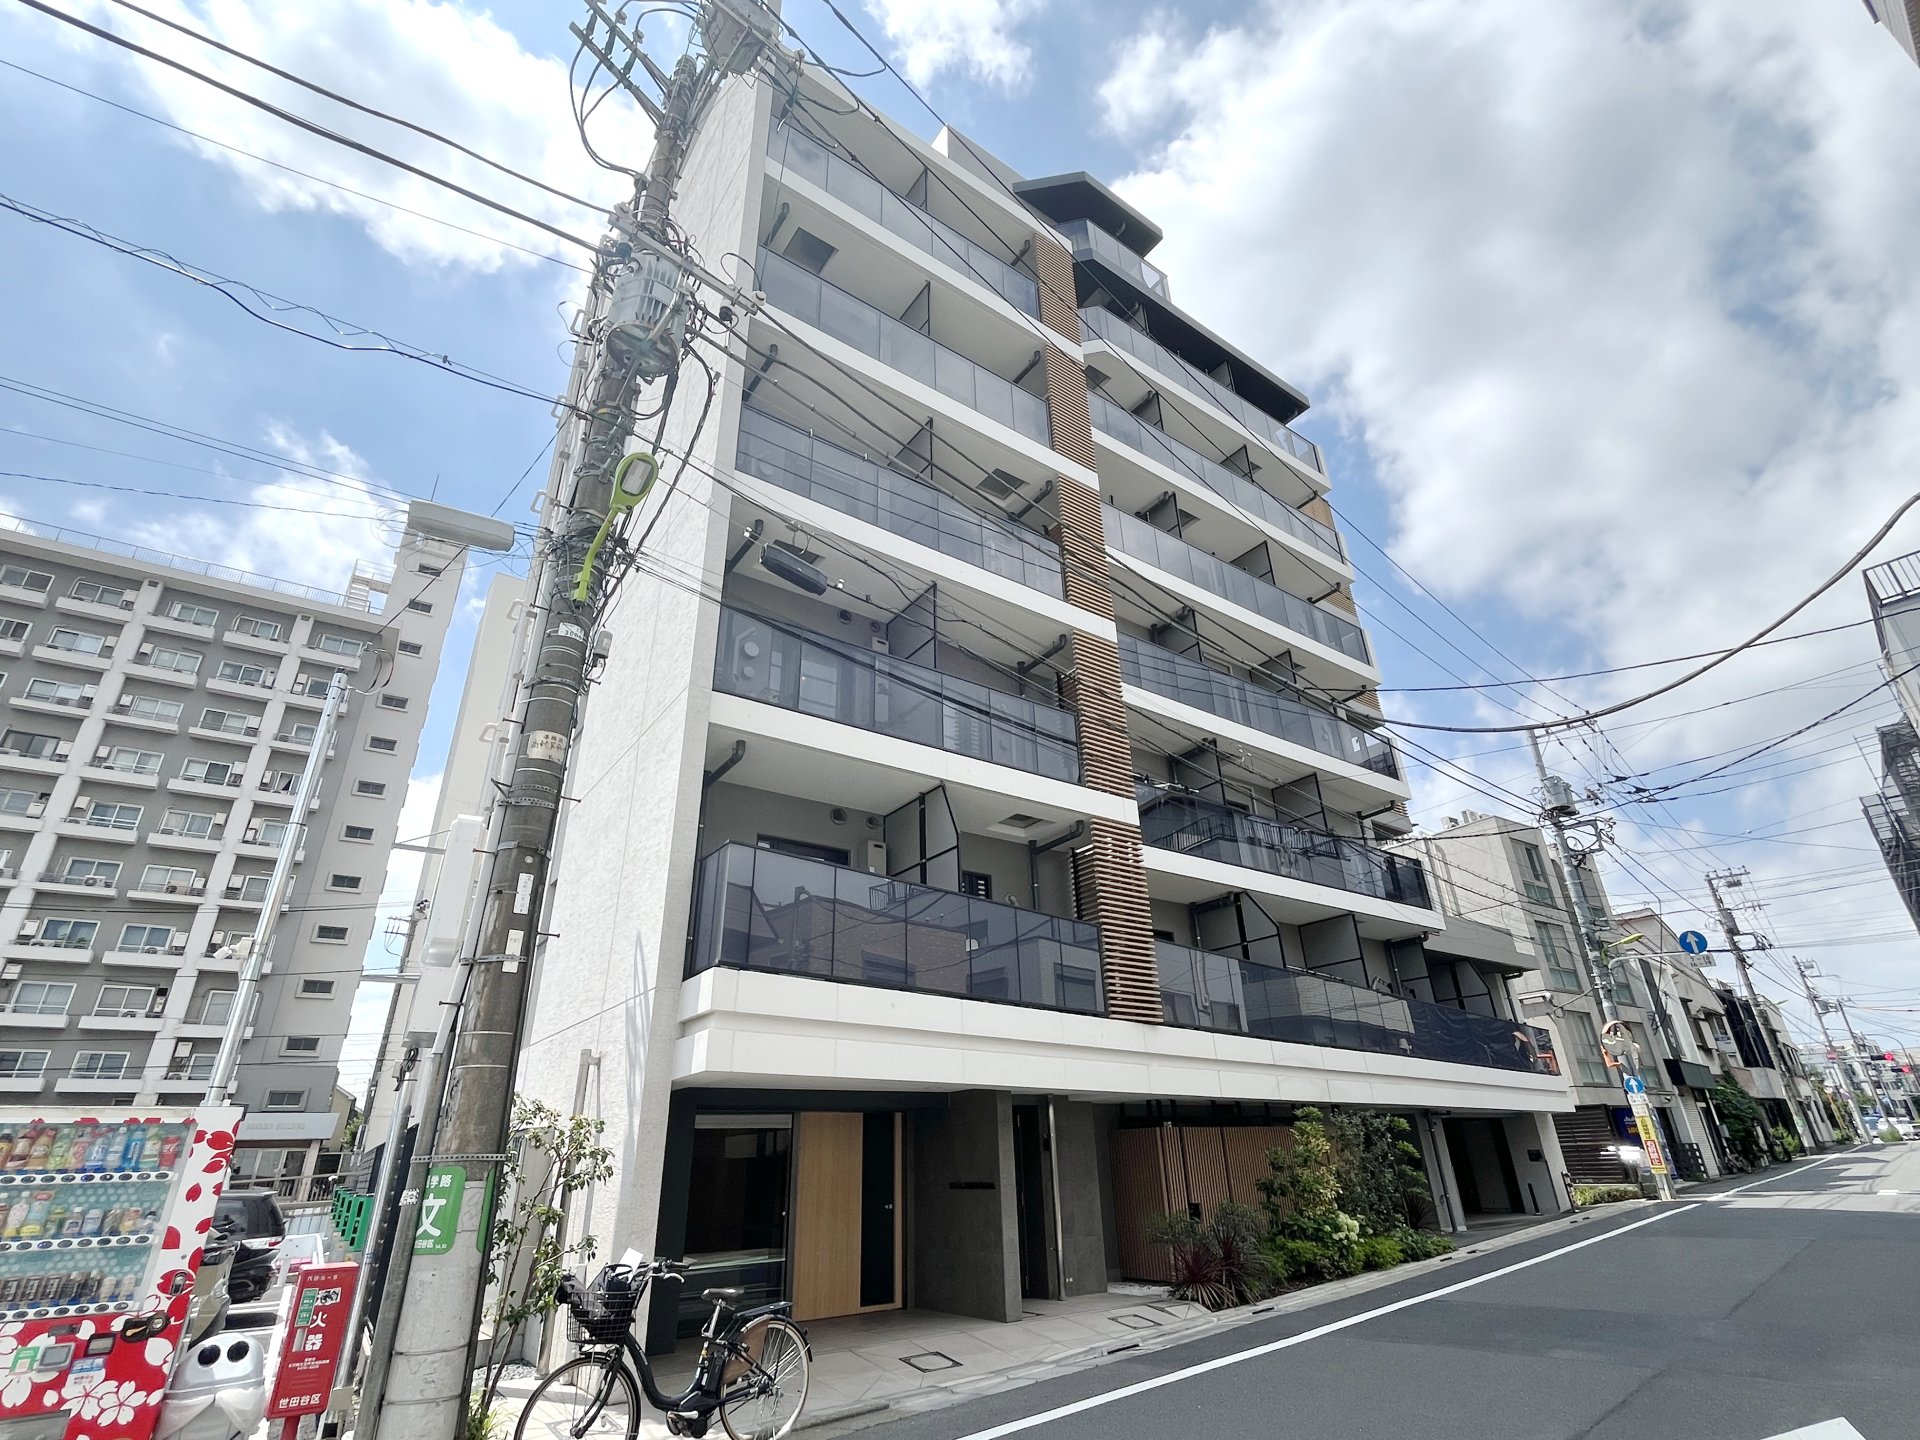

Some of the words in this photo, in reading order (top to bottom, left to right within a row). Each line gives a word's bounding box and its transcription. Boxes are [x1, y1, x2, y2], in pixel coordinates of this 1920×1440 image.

[426, 1175, 452, 1188] 学路
[416, 1193, 447, 1237] 文
[279, 1393, 321, 1409] 世田谷区
